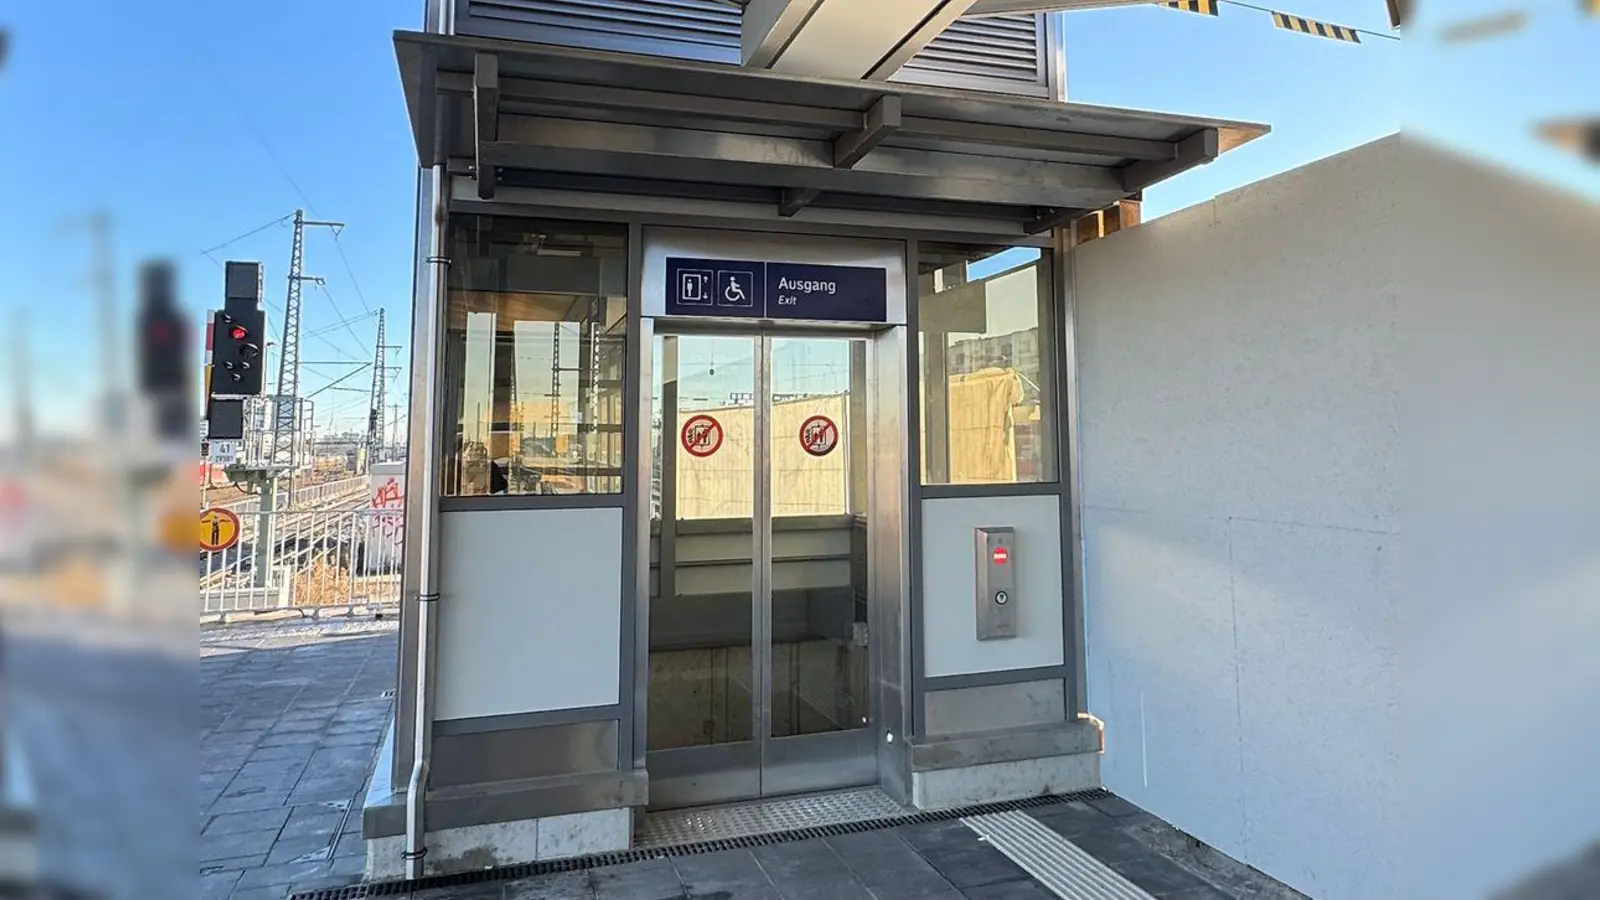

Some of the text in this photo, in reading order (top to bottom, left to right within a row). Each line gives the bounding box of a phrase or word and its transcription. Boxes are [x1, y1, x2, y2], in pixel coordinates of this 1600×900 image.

[778, 277, 836, 294] Ausgang
[778, 295, 797, 305] Exit
[219, 443, 230, 453] 41
